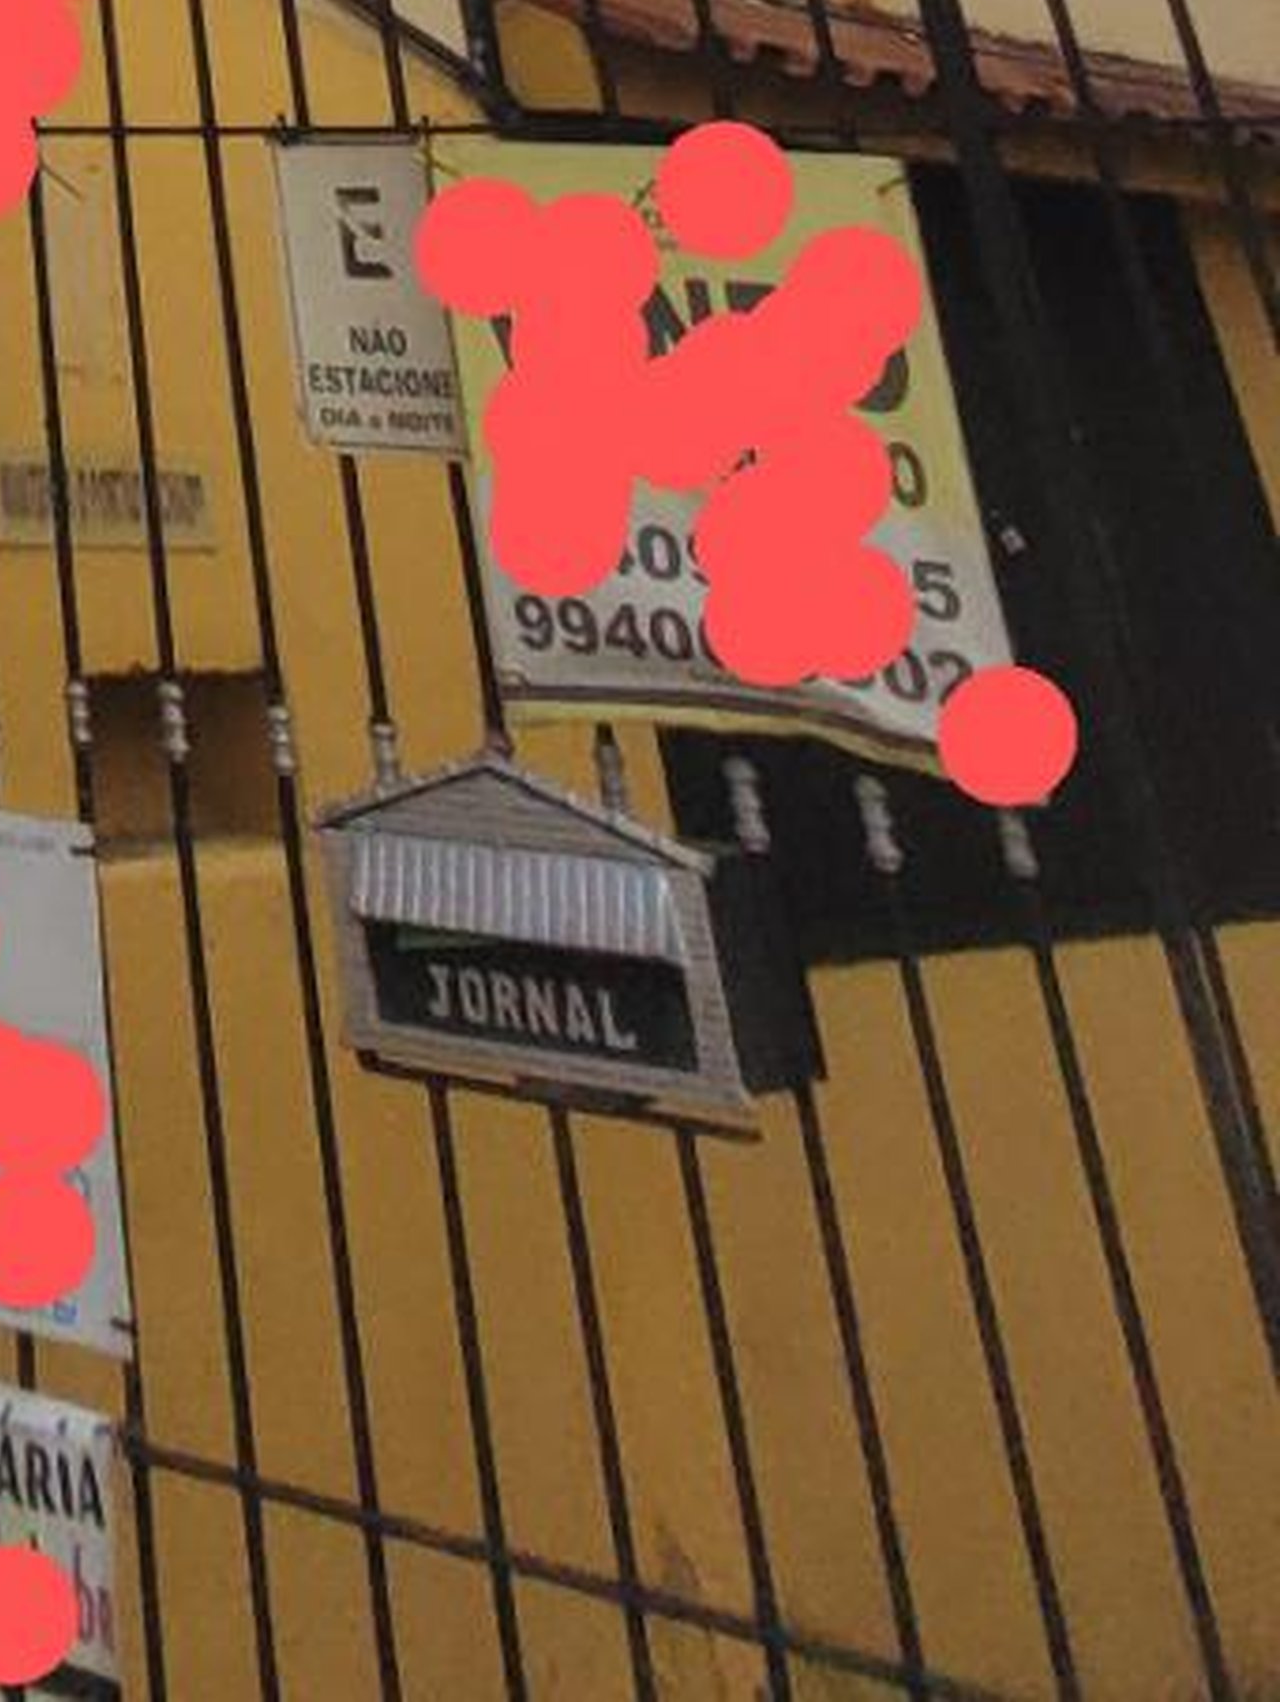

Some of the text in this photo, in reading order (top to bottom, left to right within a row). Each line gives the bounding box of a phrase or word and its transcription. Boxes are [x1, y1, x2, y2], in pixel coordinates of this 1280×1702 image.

[308, 363, 453, 399] ESTACIONE
[320, 407, 362, 429] DIA
[427, 961, 638, 1052] JORNAL
